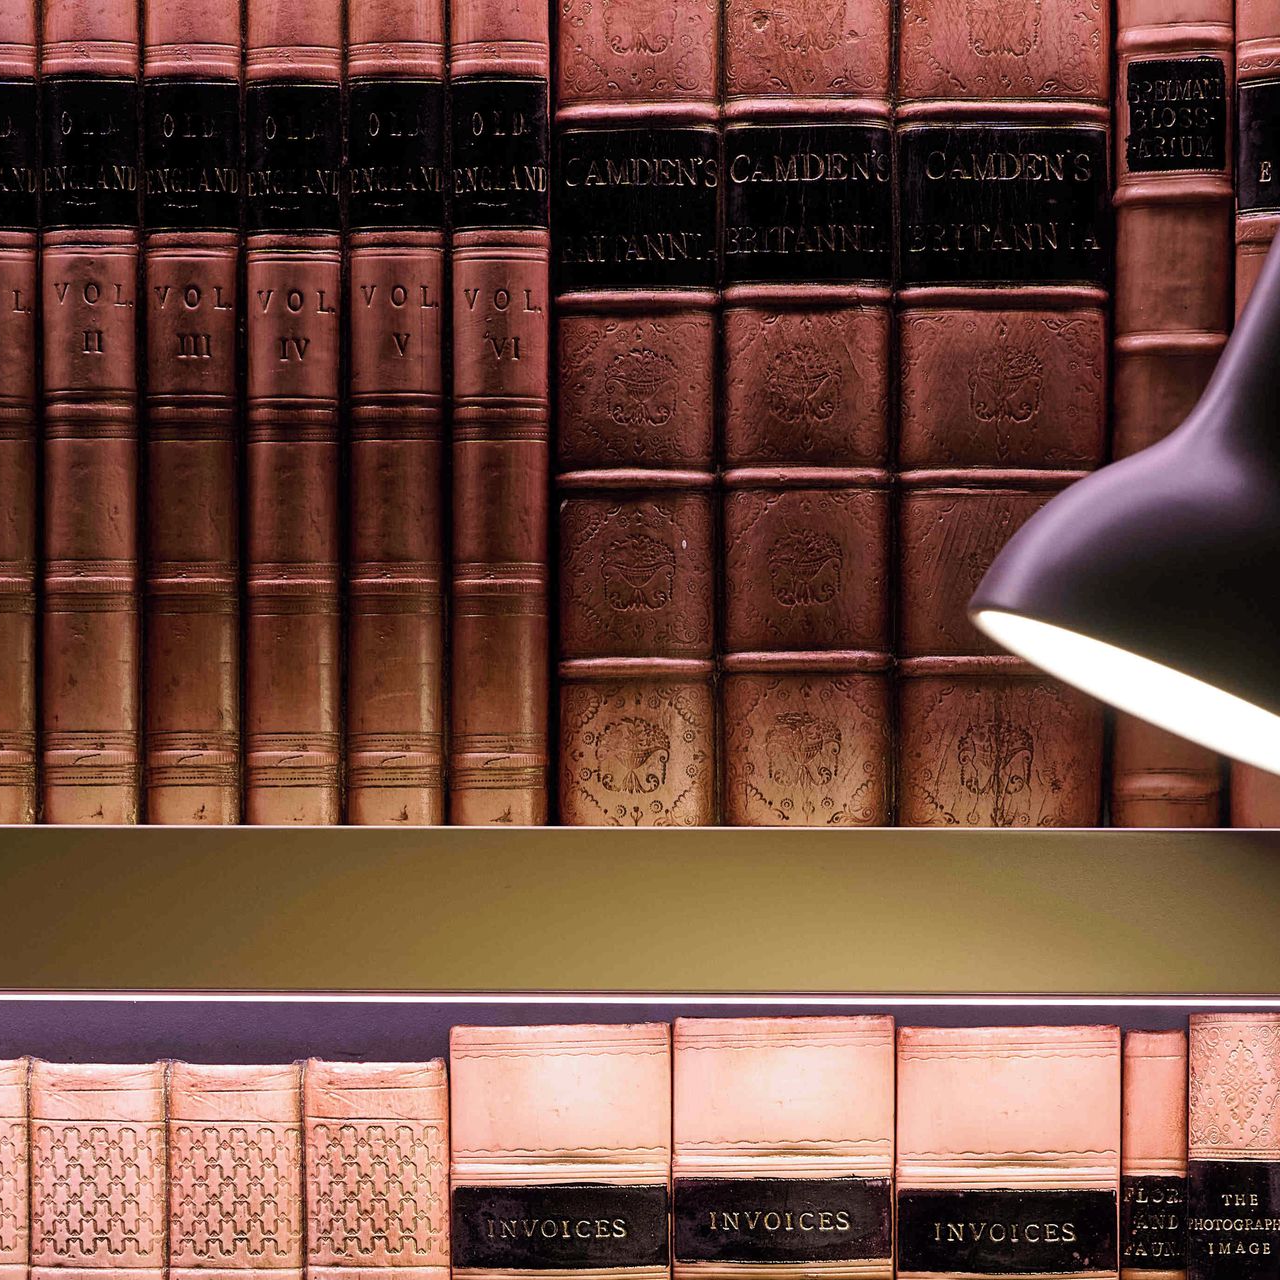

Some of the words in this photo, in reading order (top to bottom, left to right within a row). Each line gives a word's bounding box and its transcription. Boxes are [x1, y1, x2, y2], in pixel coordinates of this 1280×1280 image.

[472, 111, 528, 137] OLD
[565, 156, 718, 188] CAMDEN'S
[729, 149, 891, 185] CAMDEN'S
[926, 149, 1092, 182] CAMDEN'S
[144, 166, 239, 195] ENGLAND
[453, 165, 547, 193] ENGLAND
[54, 282, 136, 309] VOL.
[154, 285, 233, 312] VOL.
[257, 289, 337, 316] VOL.
[361, 285, 439, 310] VOL.
[463, 287, 542, 315] VOL.
[81, 330, 104, 355] II
[176, 333, 212, 359] III
[279, 336, 311, 362] IV
[392, 332, 411, 357] V
[489, 336, 521, 361] VI
[1124, 1187, 1183, 1204] FLOR
[1221, 1193, 1259, 1207] THE
[486, 1218, 628, 1240] INVOICES
[709, 1210, 851, 1233] INVOICES
[933, 1221, 1077, 1244] INVOICES
[1123, 1241, 1186, 1257] FAUN
[1208, 1242, 1271, 1256] IMAGE
